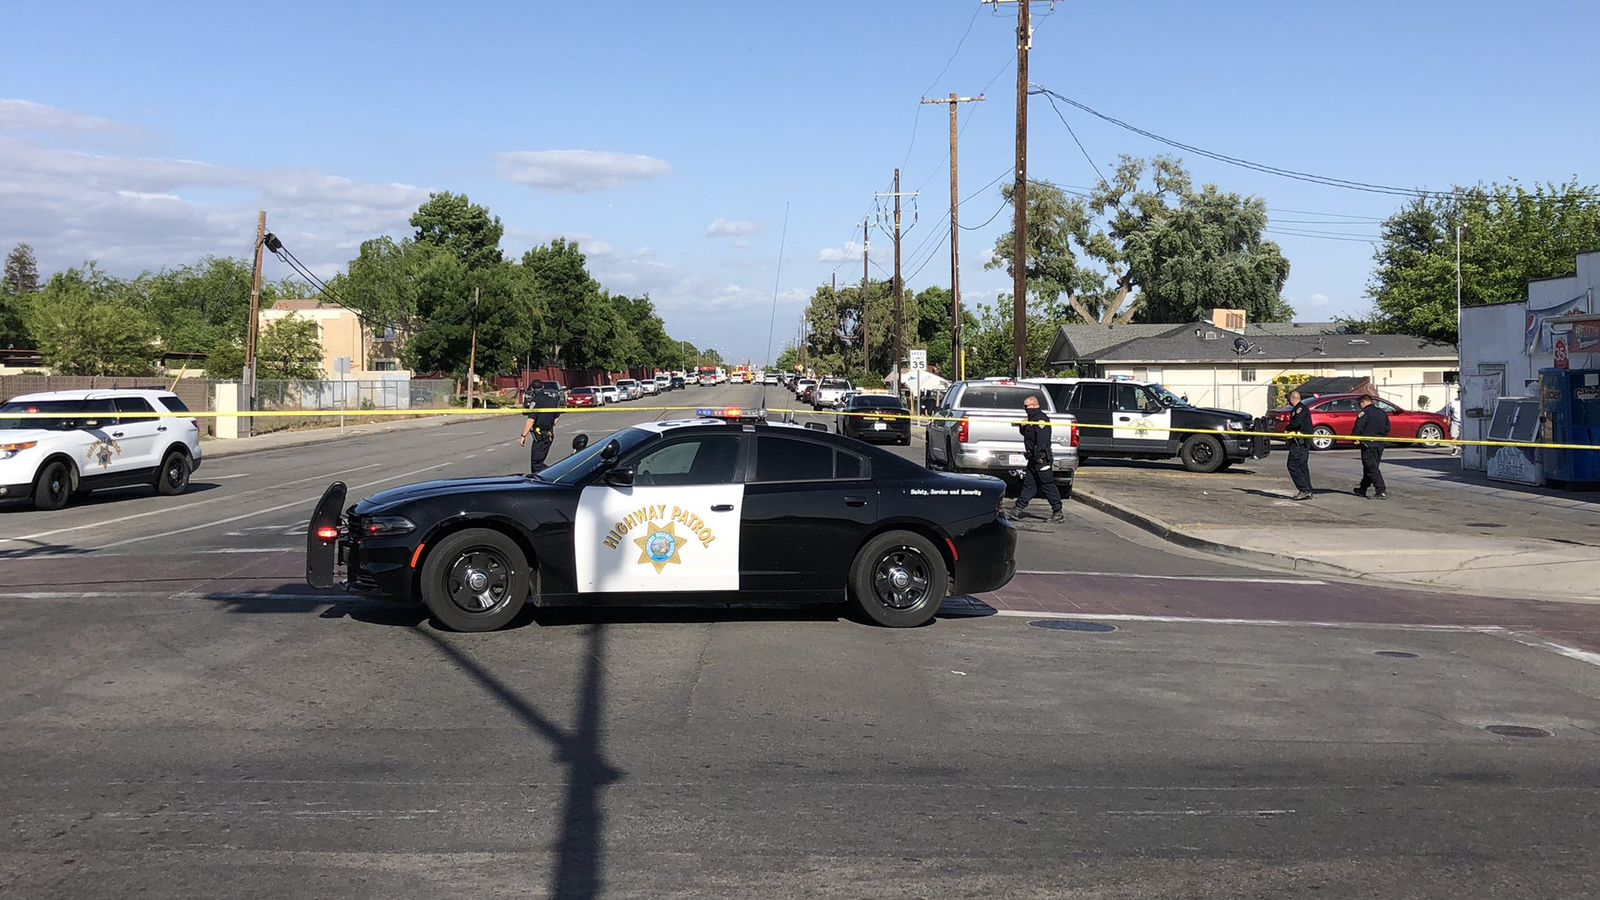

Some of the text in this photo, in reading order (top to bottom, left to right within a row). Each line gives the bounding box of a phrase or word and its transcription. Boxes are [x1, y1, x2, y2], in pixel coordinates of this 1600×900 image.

[912, 360, 925, 369] 35
[910, 488, 929, 496] Safety,
[961, 488, 982, 496] Security
[603, 504, 716, 550] HIGHWAY PATROL
